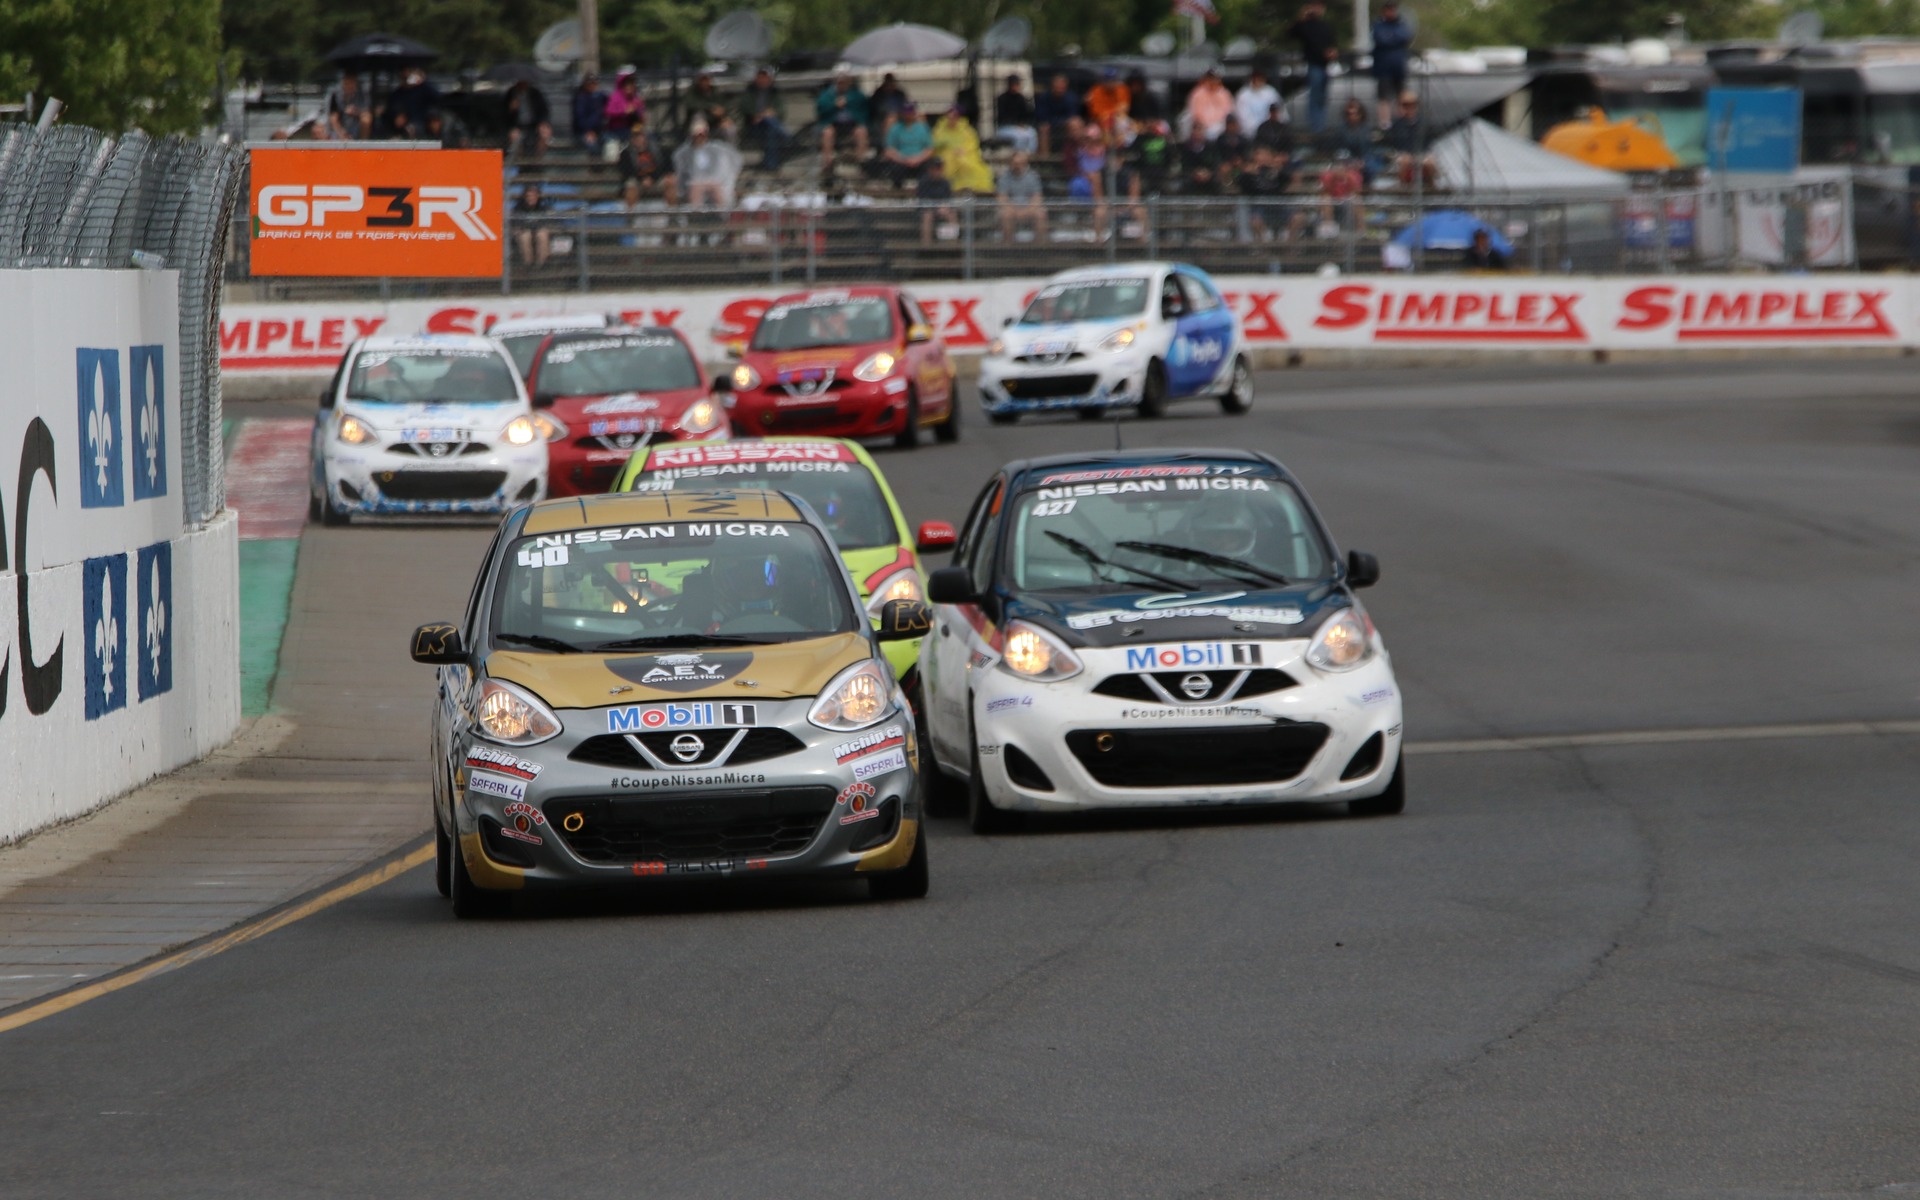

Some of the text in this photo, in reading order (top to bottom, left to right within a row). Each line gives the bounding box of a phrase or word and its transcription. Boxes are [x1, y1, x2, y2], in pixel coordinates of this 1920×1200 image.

[258, 185, 497, 240] GP3R
[258, 230, 300, 240] GRAND
[304, 230, 332, 240] PRIX
[336, 230, 352, 240] DE
[1313, 285, 1587, 342] SIMPLEX
[1616, 286, 1894, 341] SIMPLEX
[655, 448, 839, 466] NISSAN
[654, 461, 850, 481] NISSAN MICRA
[1038, 478, 1270, 501] NISSAN MICRA
[1031, 499, 1078, 517] 427
[536, 523, 790, 548] NISSAN MICRA
[517, 545, 569, 569] 40
[1127, 641, 1224, 670] Mobil
[641, 673, 726, 684] Construction
[643, 664, 723, 678] AEY
[607, 703, 714, 732] Mobil
[855, 753, 904, 777] SAFARI 4
[471, 777, 522, 800] SAFARI 4
[611, 773, 766, 790] #CoupeNissanMicra
[837, 782, 876, 805] SCORES
[504, 803, 545, 825] SCORES
